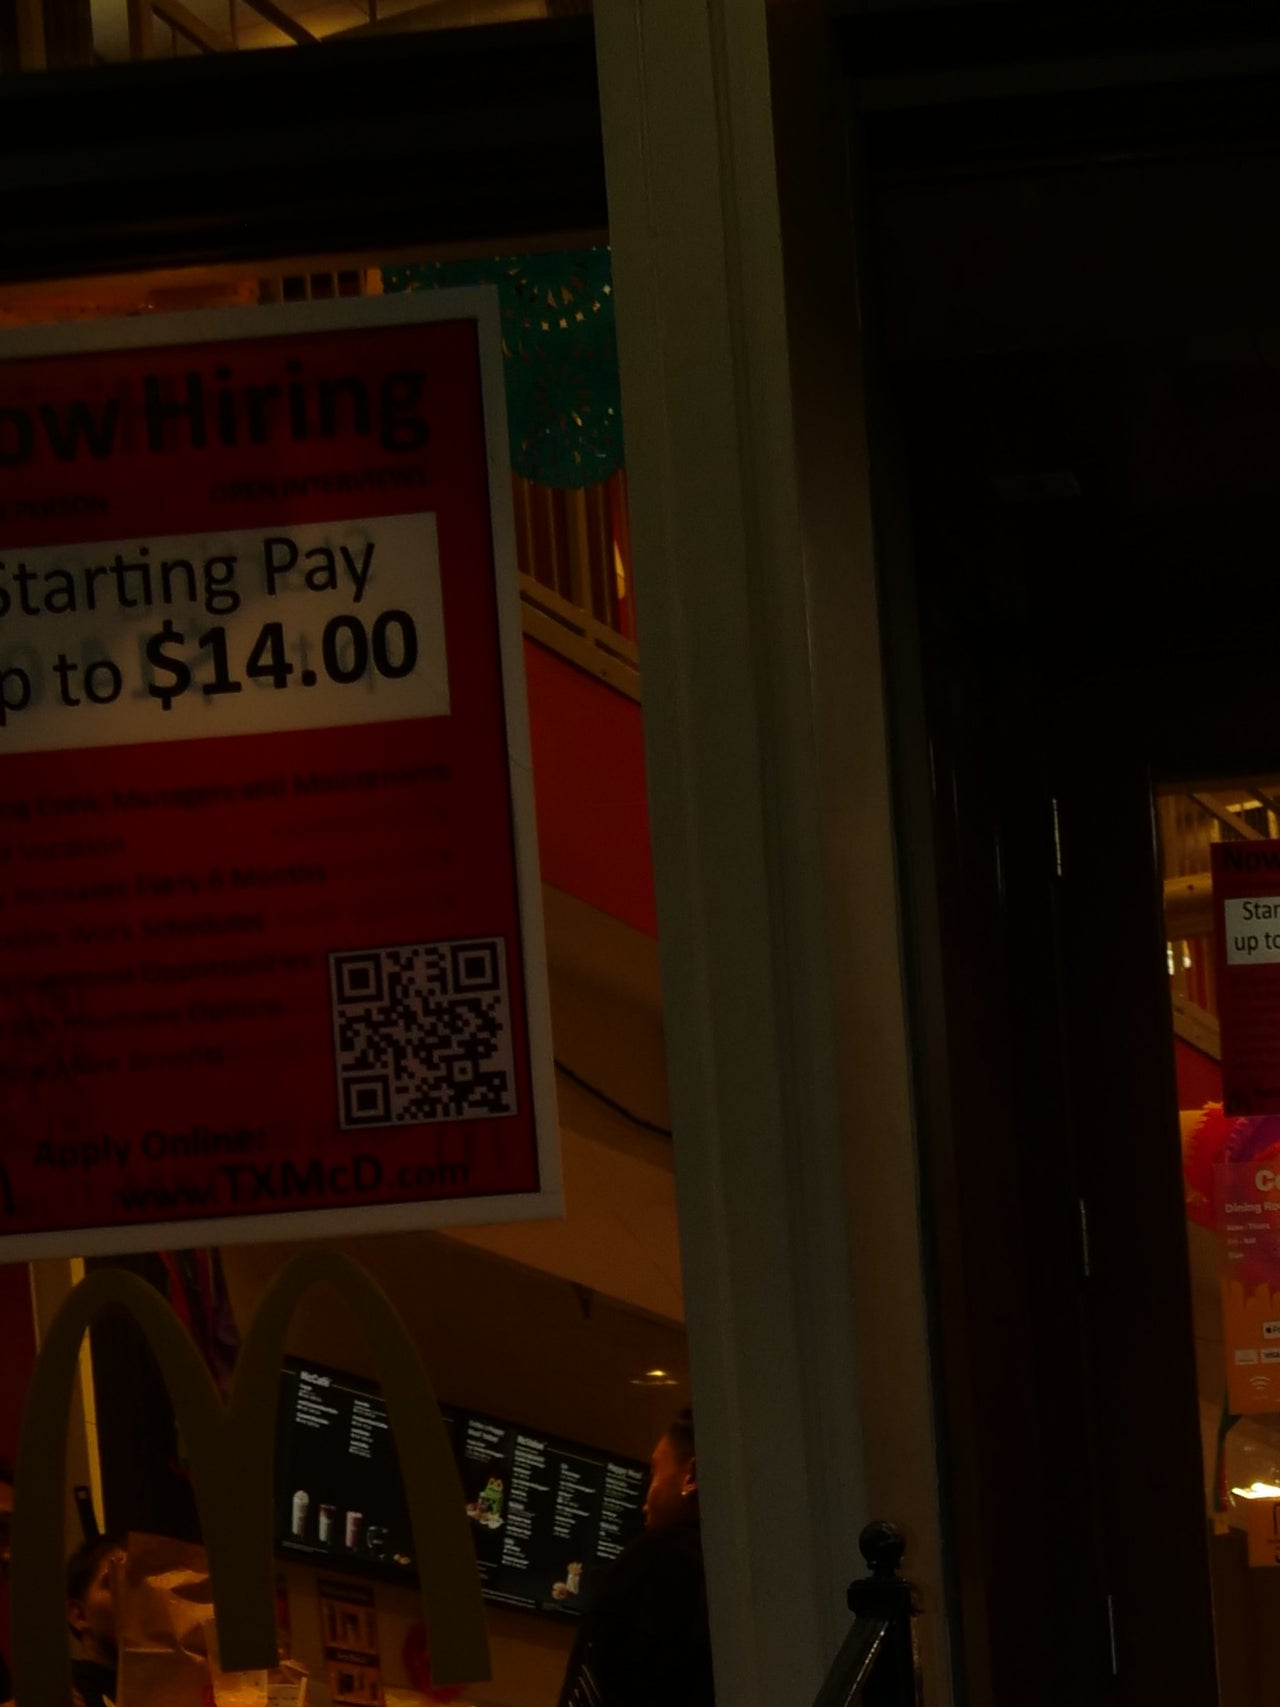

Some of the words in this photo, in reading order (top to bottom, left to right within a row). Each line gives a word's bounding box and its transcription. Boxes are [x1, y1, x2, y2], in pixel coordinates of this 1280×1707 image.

[144, 357, 430, 453] Hiring
[263, 537, 375, 603] Pay
[54, 654, 121, 706] to
[147, 610, 418, 710] $14.00
[1234, 936, 1259, 953] up
[33, 1133, 130, 1173] Apply
[140, 1124, 268, 1161] Online:
[117, 1153, 471, 1212] www.TXMcD.com
[1225, 1202, 1262, 1215] Dining
